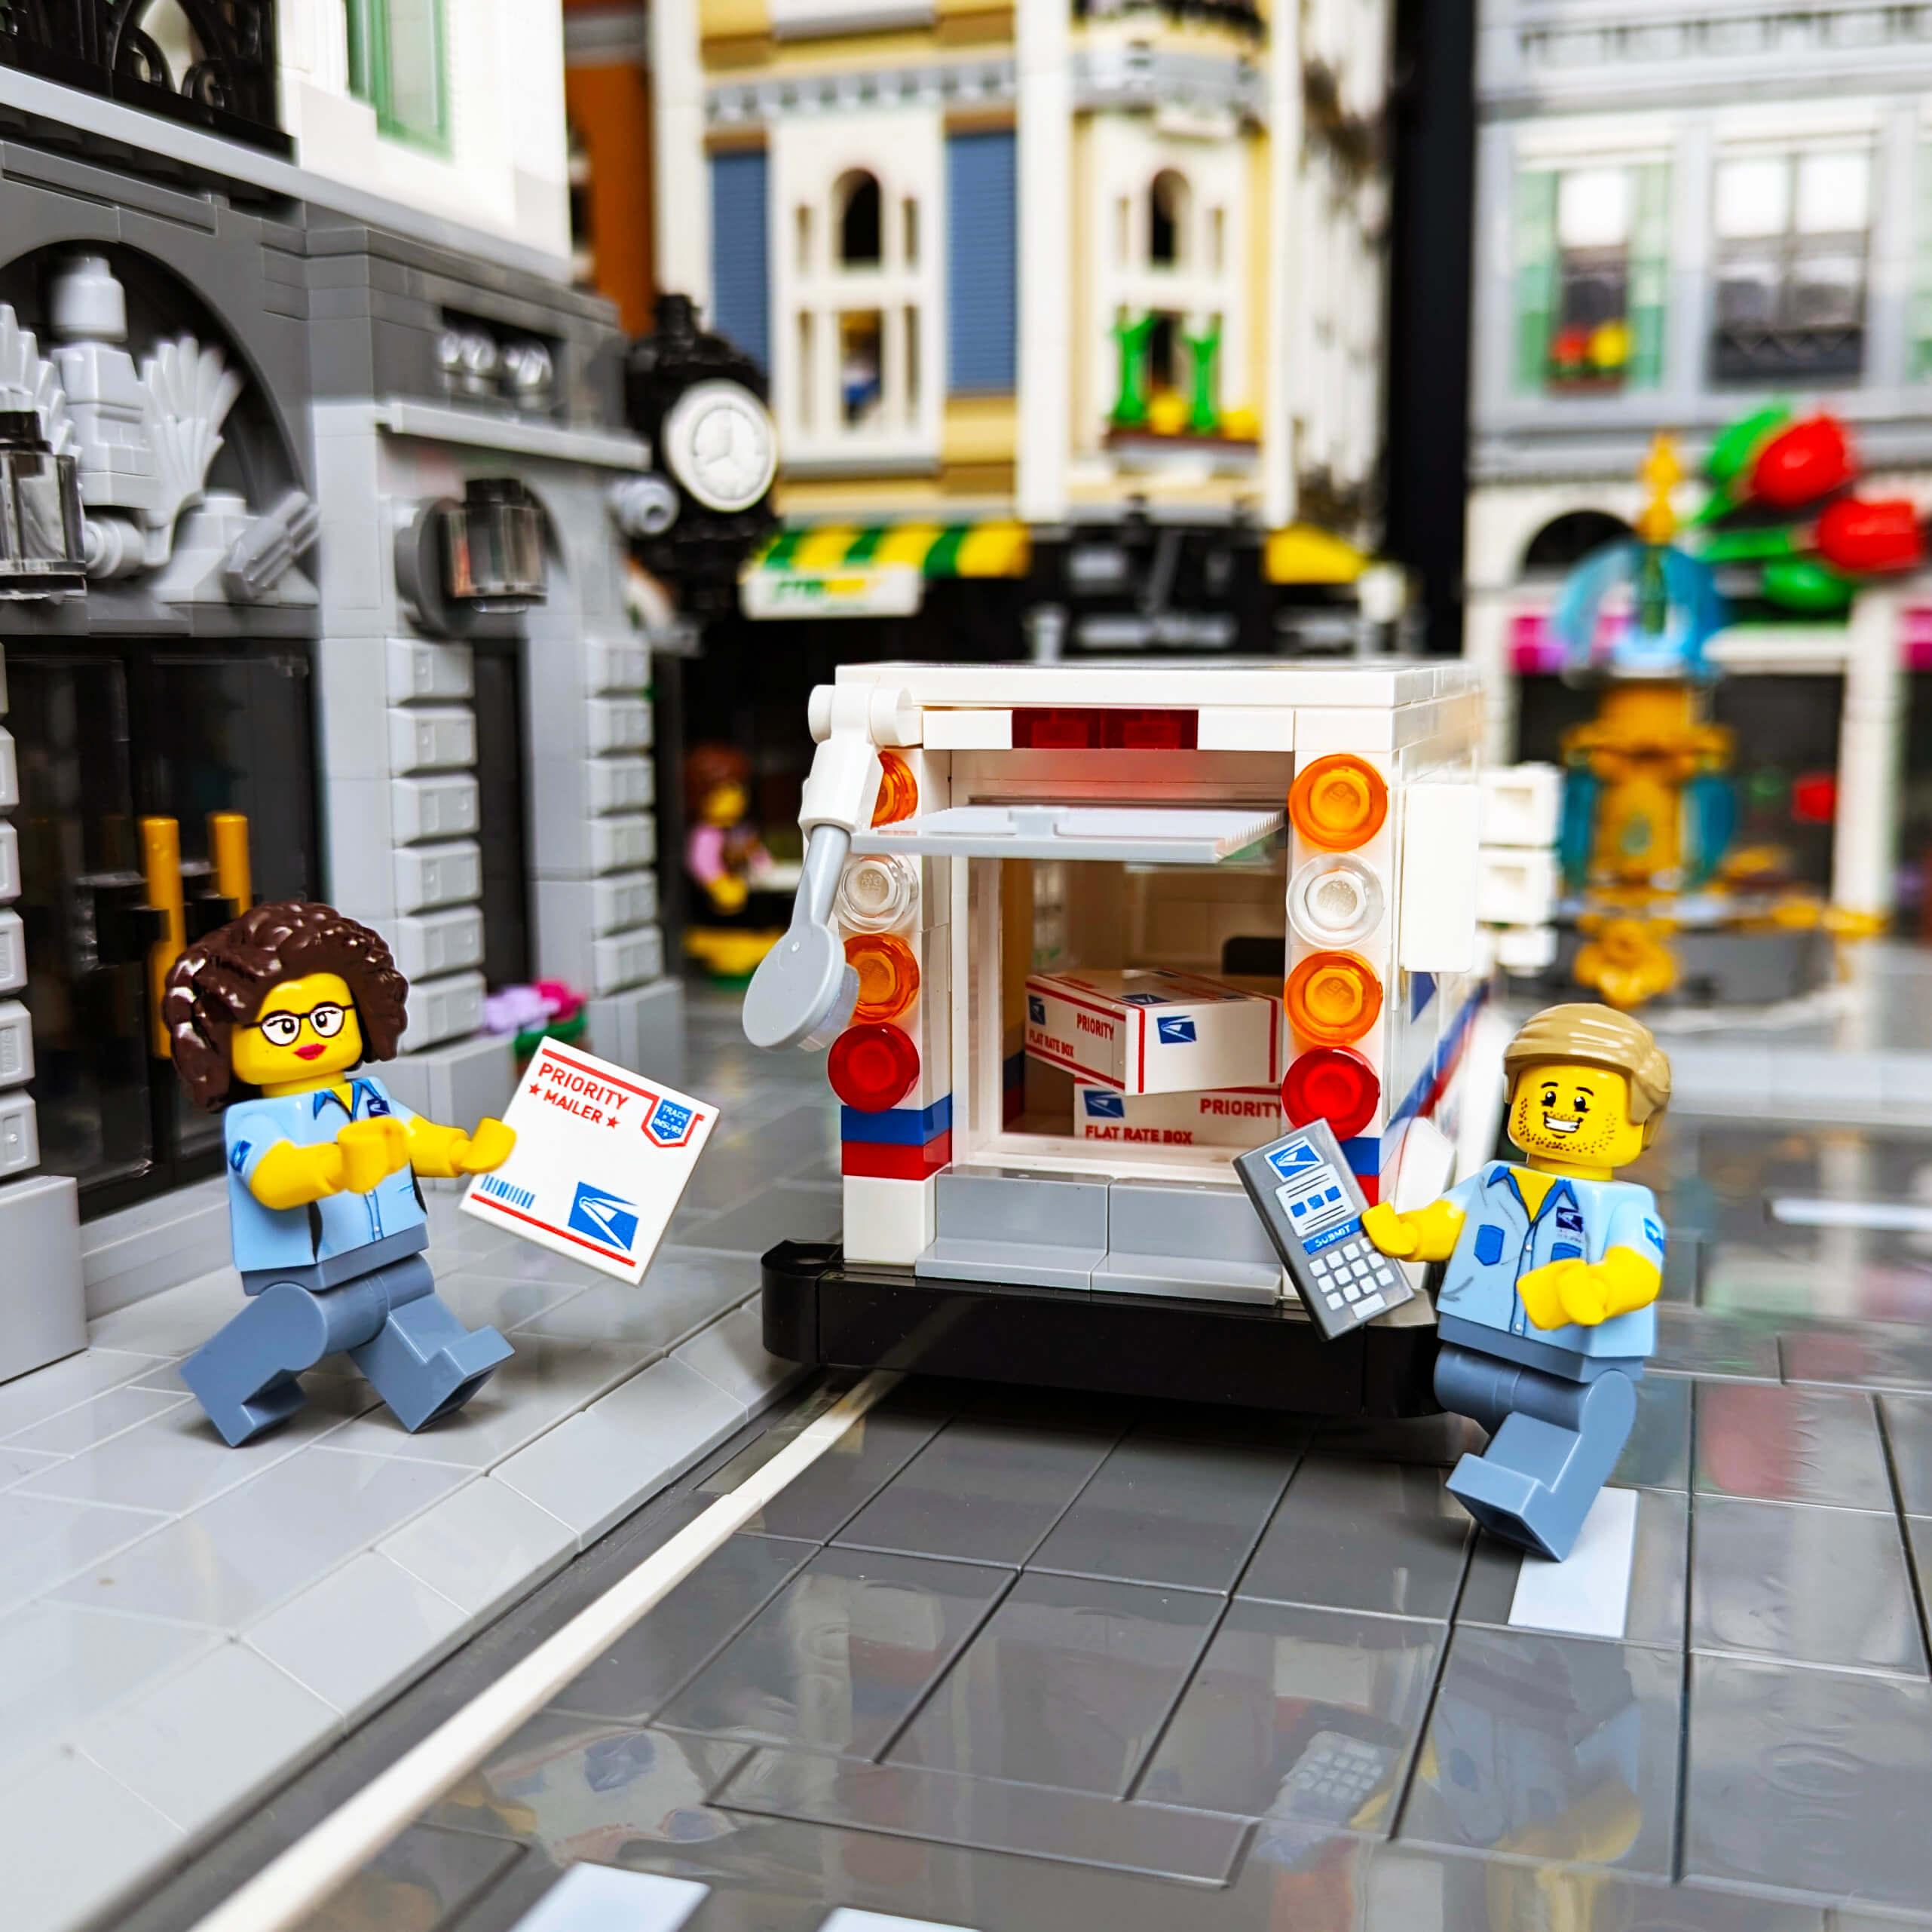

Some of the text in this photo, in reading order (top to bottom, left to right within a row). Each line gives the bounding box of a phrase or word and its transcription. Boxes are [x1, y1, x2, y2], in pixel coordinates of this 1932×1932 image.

[1076, 1013, 1114, 1041] PRIORITY
[1030, 1029, 1074, 1058] FLAT RATE BOX
[538, 1062, 629, 1110] PRIORITY
[543, 1089, 603, 1123] MAILER
[663, 1104, 689, 1122] TRACK
[1199, 1098, 1281, 1118] PRIORITY
[654, 1118, 683, 1135] INSURE
[1085, 1125, 1193, 1144] FLAT RATE BOX
[1315, 1224, 1351, 1248] SUBMIT
